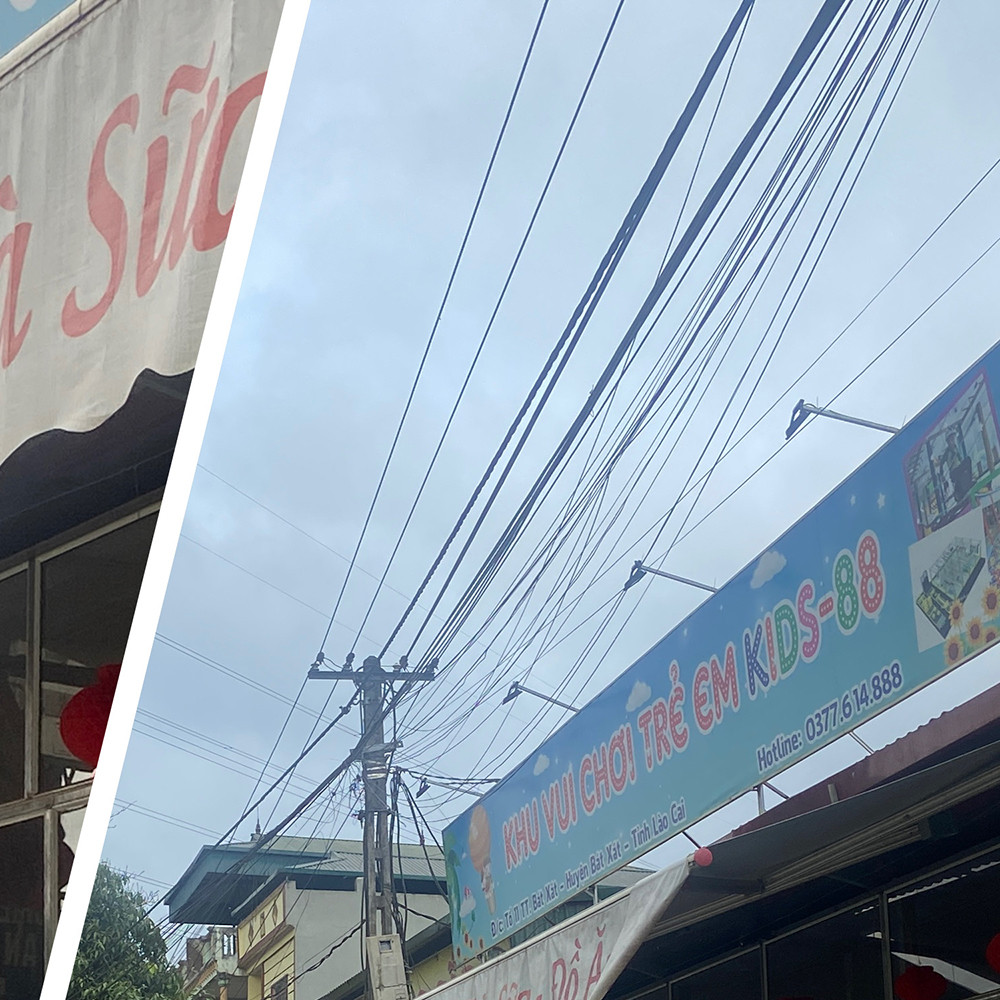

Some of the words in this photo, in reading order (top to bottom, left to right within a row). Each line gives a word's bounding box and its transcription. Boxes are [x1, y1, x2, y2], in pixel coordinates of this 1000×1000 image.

[503, 799, 540, 870] KHU
[541, 772, 577, 839] VUI
[579, 726, 636, 814] CHƠI
[638, 663, 689, 769] TRẺ
[693, 646, 740, 731] EM
[744, 535, 884, 696] KIDS-88
[758, 733, 802, 771] Hotline:
